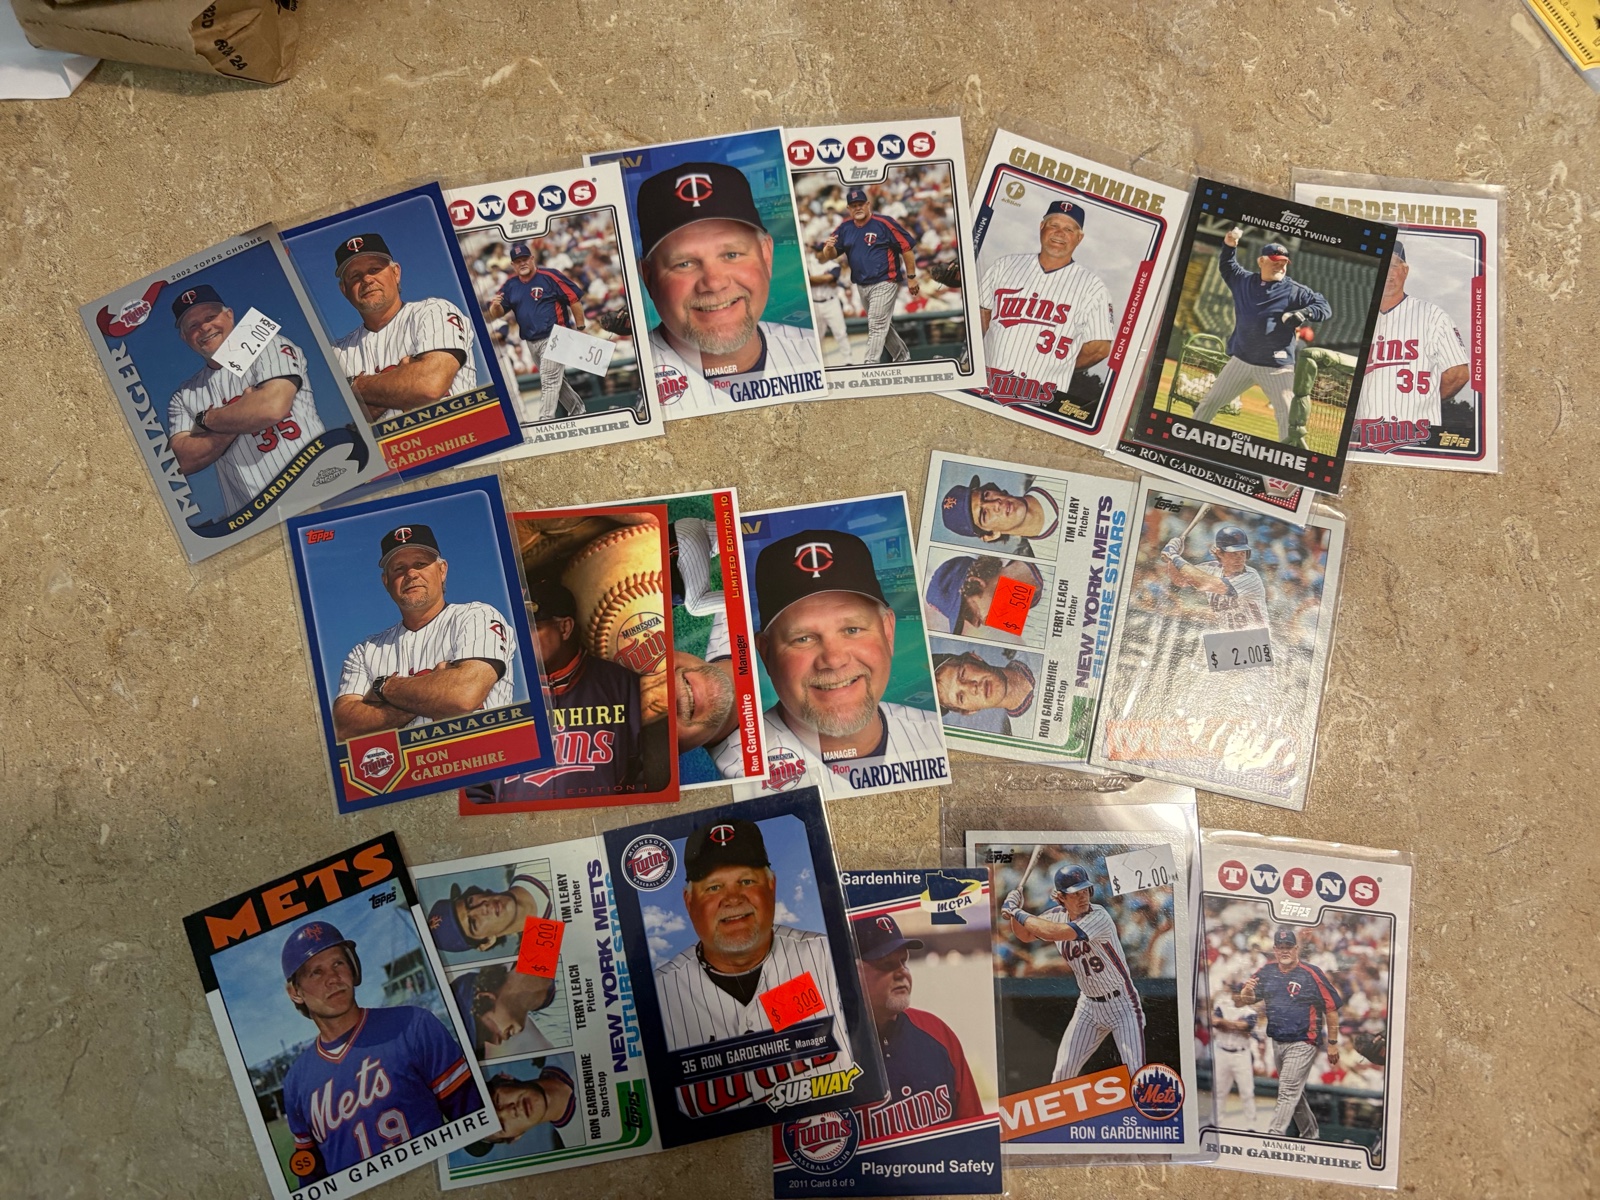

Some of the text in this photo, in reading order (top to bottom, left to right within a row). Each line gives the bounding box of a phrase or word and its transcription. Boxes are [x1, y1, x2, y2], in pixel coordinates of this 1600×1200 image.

[786, 135, 934, 163] TWINS
[1008, 146, 1166, 214] GARDENHIRE
[449, 182, 595, 223] TWINS
[1241, 214, 1337, 244] MINNESOTA TWINS
[171, 236, 264, 281] 2002 TOPPS CHROME
[993, 287, 1071, 326] Twins
[1113, 271, 1149, 361] RON GARDENHIRE
[228, 324, 270, 371] $ 2.00
[1036, 329, 1074, 360] 35
[1474, 288, 1482, 382] RON GARDENHIRE
[579, 346, 603, 366] .50
[704, 364, 738, 377] MANAGER
[713, 370, 824, 403] Ron GARDENHIRE
[848, 373, 954, 388] GARDENHIRE
[861, 369, 902, 378] MANAGER
[980, 367, 1057, 402] Twins
[1396, 368, 1431, 394] 35
[382, 390, 490, 434] MANAGER
[535, 421, 577, 433] MANAGER
[110, 341, 200, 521] MANAGER
[252, 412, 302, 453] 35
[389, 436, 422, 456] RON
[525, 421, 630, 444] GARDENHIRE
[1171, 422, 1308, 472] GARDENHIRE
[1231, 431, 1252, 442] RON
[1353, 416, 1431, 449] Twins
[387, 432, 478, 469] GARDENHIRE
[228, 440, 325, 530] RON GARDENHIRE
[1139, 446, 1168, 466] RON
[1169, 457, 1255, 495] GARDENHIRE
[1065, 496, 1080, 543] TIM LEARY
[1078, 506, 1090, 537] Pitcher
[1091, 495, 1113, 560] METS
[720, 495, 740, 598] LIMITED EDITION 10
[1052, 579, 1069, 638] TERRY LEACH
[1066, 594, 1078, 627] Pitcher
[1082, 565, 1104, 628] YORK
[1092, 510, 1127, 679] FUTURE STARS
[621, 616, 662, 639] MINNESOTA
[1075, 632, 1095, 689] NEW
[1210, 645, 1262, 668] $ 2.00
[739, 634, 760, 772] Ron Gardenhire Manager
[1039, 659, 1059, 738] RON GARDENHIRE
[1053, 680, 1069, 723] Shortstop
[410, 707, 524, 742] MANAGER
[359, 752, 395, 778] Twins
[411, 750, 507, 781] GARDENHIRE
[416, 749, 449, 767] RON
[823, 748, 858, 761] MANAGER
[567, 784, 635, 796] EDITION
[832, 756, 948, 790] Ron GARDENHIRE
[626, 849, 671, 878] Twins
[628, 839, 667, 857] MINNESOTA
[556, 873, 570, 904] LEARY
[632, 869, 671, 887] BASEBALL CLUB
[840, 872, 921, 886] Gardenhire
[1112, 875, 1121, 894] $
[1135, 865, 1169, 890] 2.00
[1220, 864, 1376, 901] TWINS
[204, 843, 394, 950] METS
[572, 880, 583, 914] Pitcher
[937, 895, 972, 912] MCPA
[587, 859, 629, 1074] NEW YORK METS
[1081, 955, 1105, 977] 19
[568, 964, 587, 1030] TERRY LEACH
[584, 978, 597, 1013] Pitcher
[616, 960, 642, 1059] FUTURE
[681, 1034, 828, 1074] 35 RON GARDENHIRE Manager
[309, 1055, 392, 1144] Mets
[581, 1053, 601, 1140] RON GARDENHIRE
[597, 1071, 611, 1118] Shortstop
[770, 1065, 860, 1107] SUBWAY
[1138, 1083, 1176, 1105] Mets
[855, 1084, 953, 1142] Twins
[998, 1076, 1126, 1133] METS
[1122, 1116, 1138, 1126] SS
[353, 1107, 412, 1160] 19
[786, 1116, 853, 1151] Twins
[1070, 1126, 1180, 1140] RON GARDENHIRE
[1262, 1140, 1306, 1153] MANAGER
[292, 1110, 490, 1200] RON GARDENHIRE
[295, 1156, 312, 1171] SS
[792, 1149, 851, 1171] BASEBALL CLUB
[861, 1160, 995, 1178] Playground Safety
[1206, 1142, 1362, 1170] RON GARDENHIRE
[788, 1178, 855, 1188] 2011 Card 8 of 9
